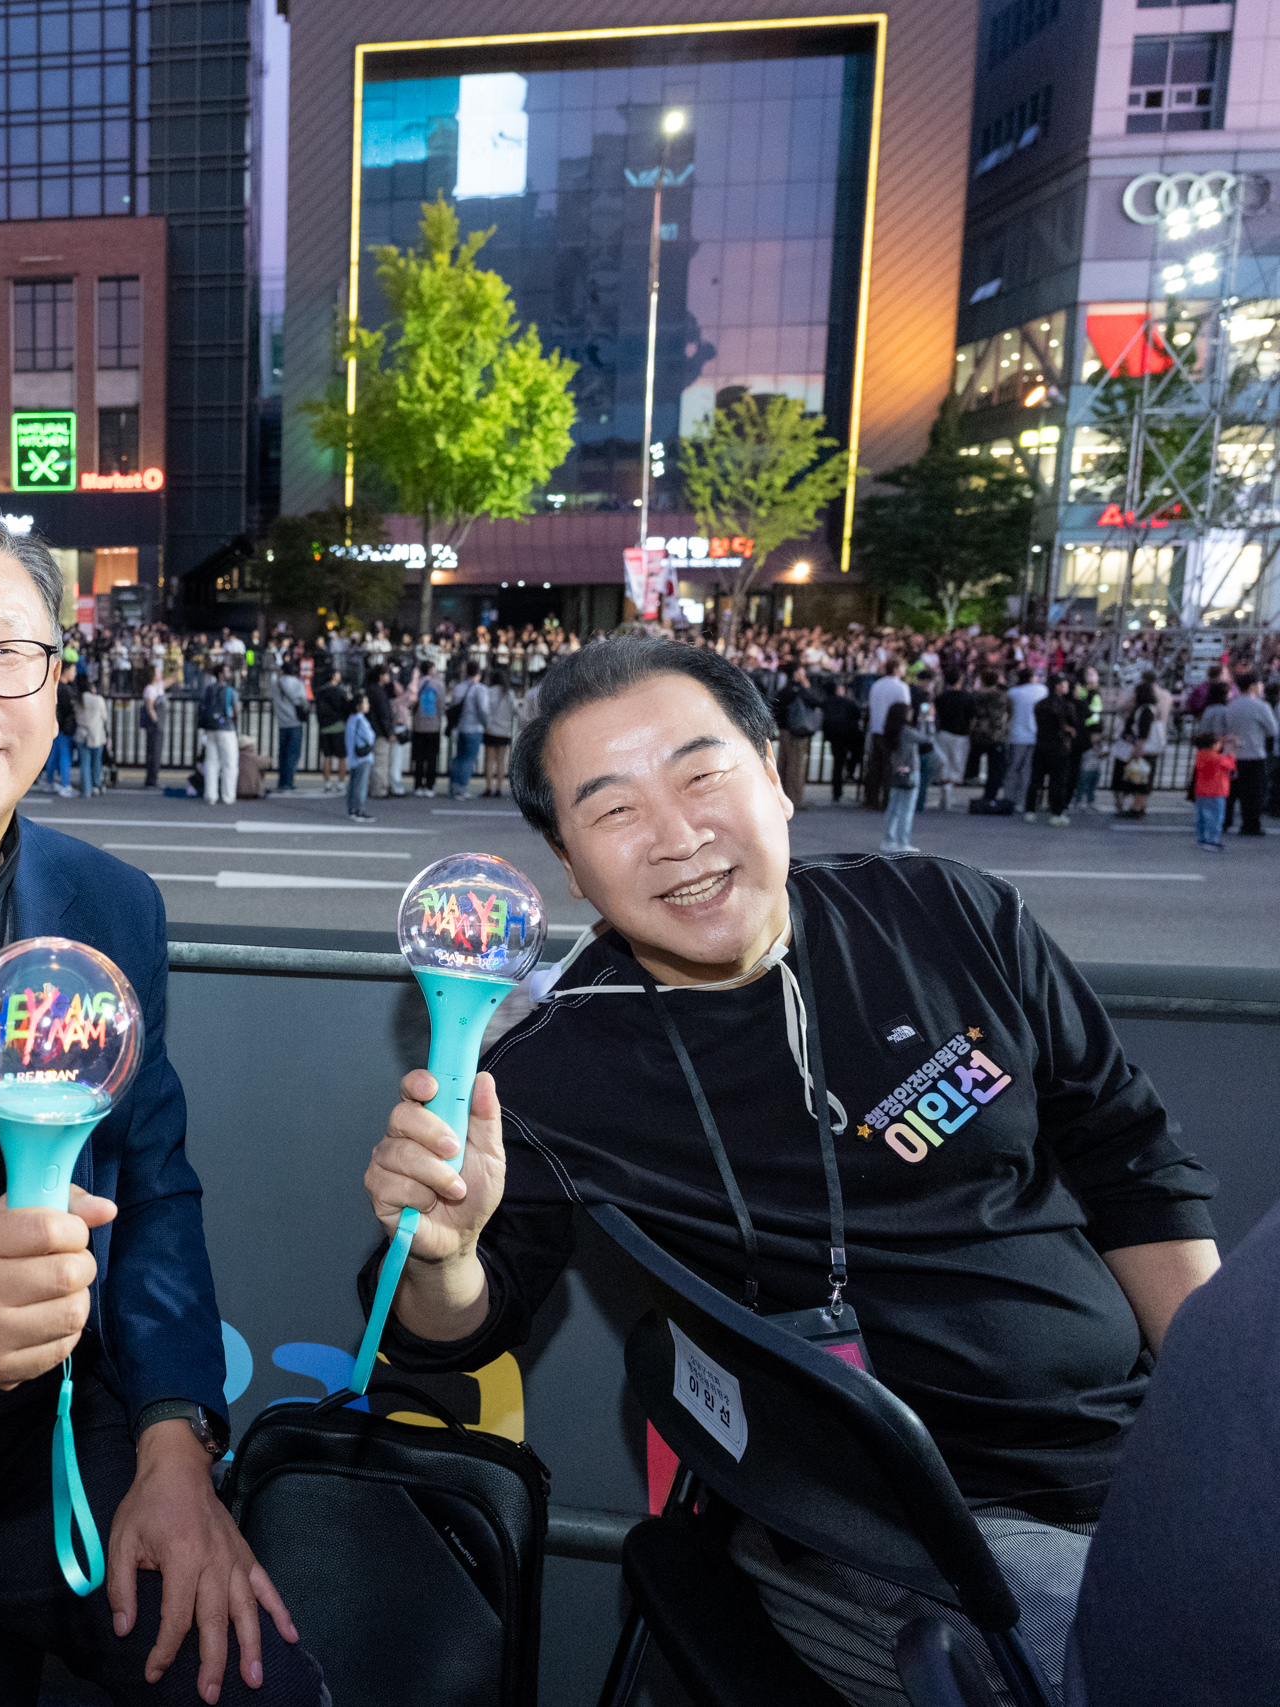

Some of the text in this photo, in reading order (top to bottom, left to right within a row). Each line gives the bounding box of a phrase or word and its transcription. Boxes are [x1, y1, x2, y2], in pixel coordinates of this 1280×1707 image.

[81, 467, 164, 491] Market O
[863, 1034, 971, 1130] 행정안전위원장
[884, 1049, 1012, 1163] 이인선
